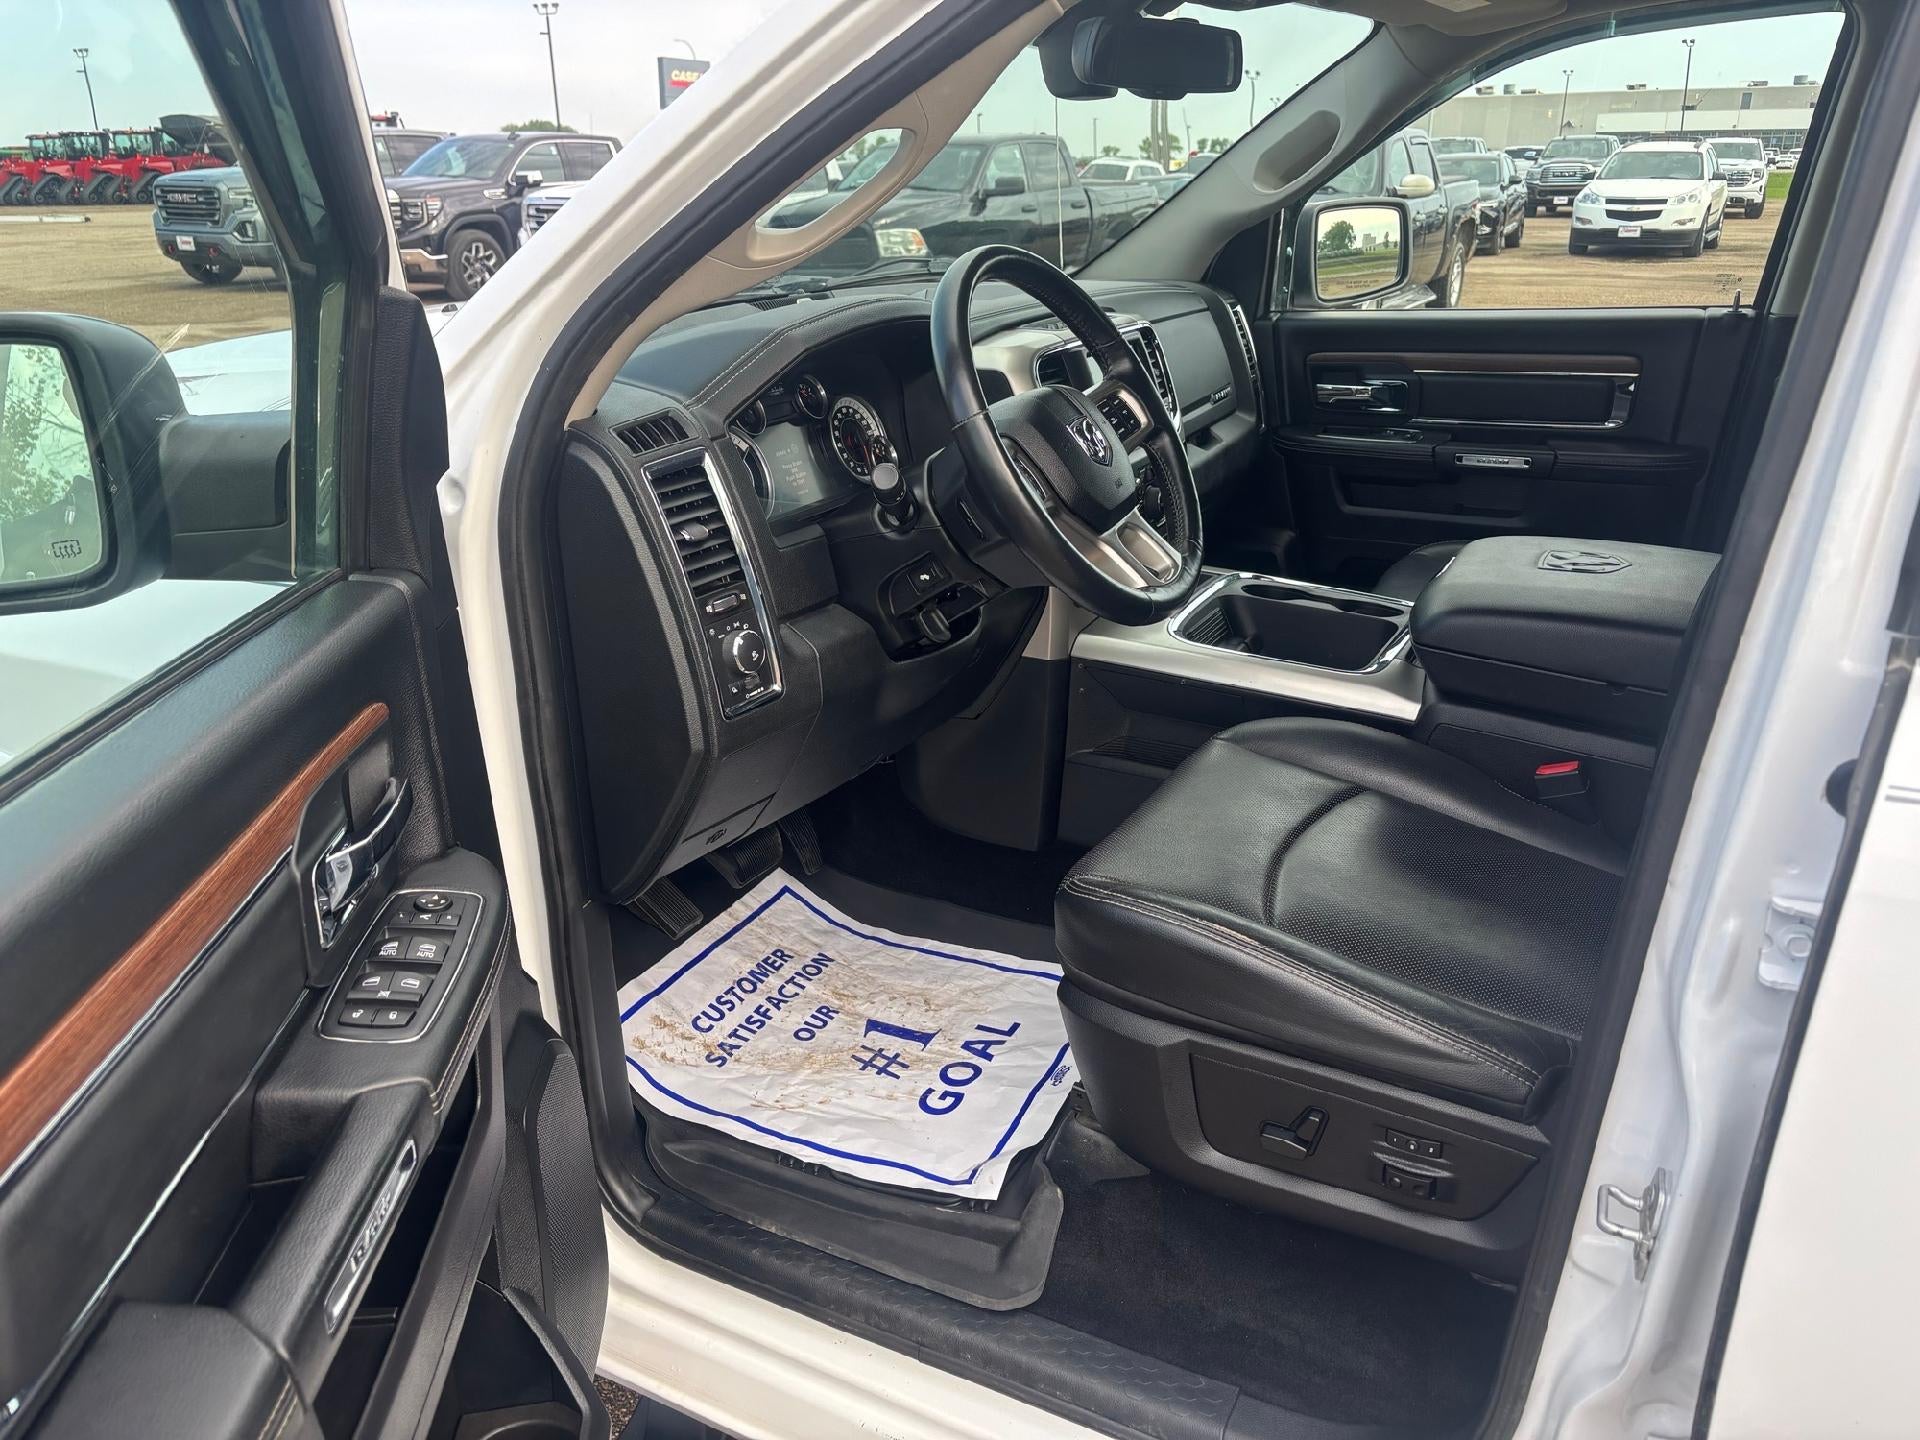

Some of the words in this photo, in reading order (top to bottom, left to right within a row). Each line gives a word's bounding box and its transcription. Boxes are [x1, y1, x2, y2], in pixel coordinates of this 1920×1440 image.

[691, 948, 794, 1034] CUSTOMER
[705, 952, 836, 1068] SATISFACTION
[793, 1005, 840, 1042] OUR
[851, 1018, 942, 1080] #1
[918, 1022, 1021, 1115] GOAL
